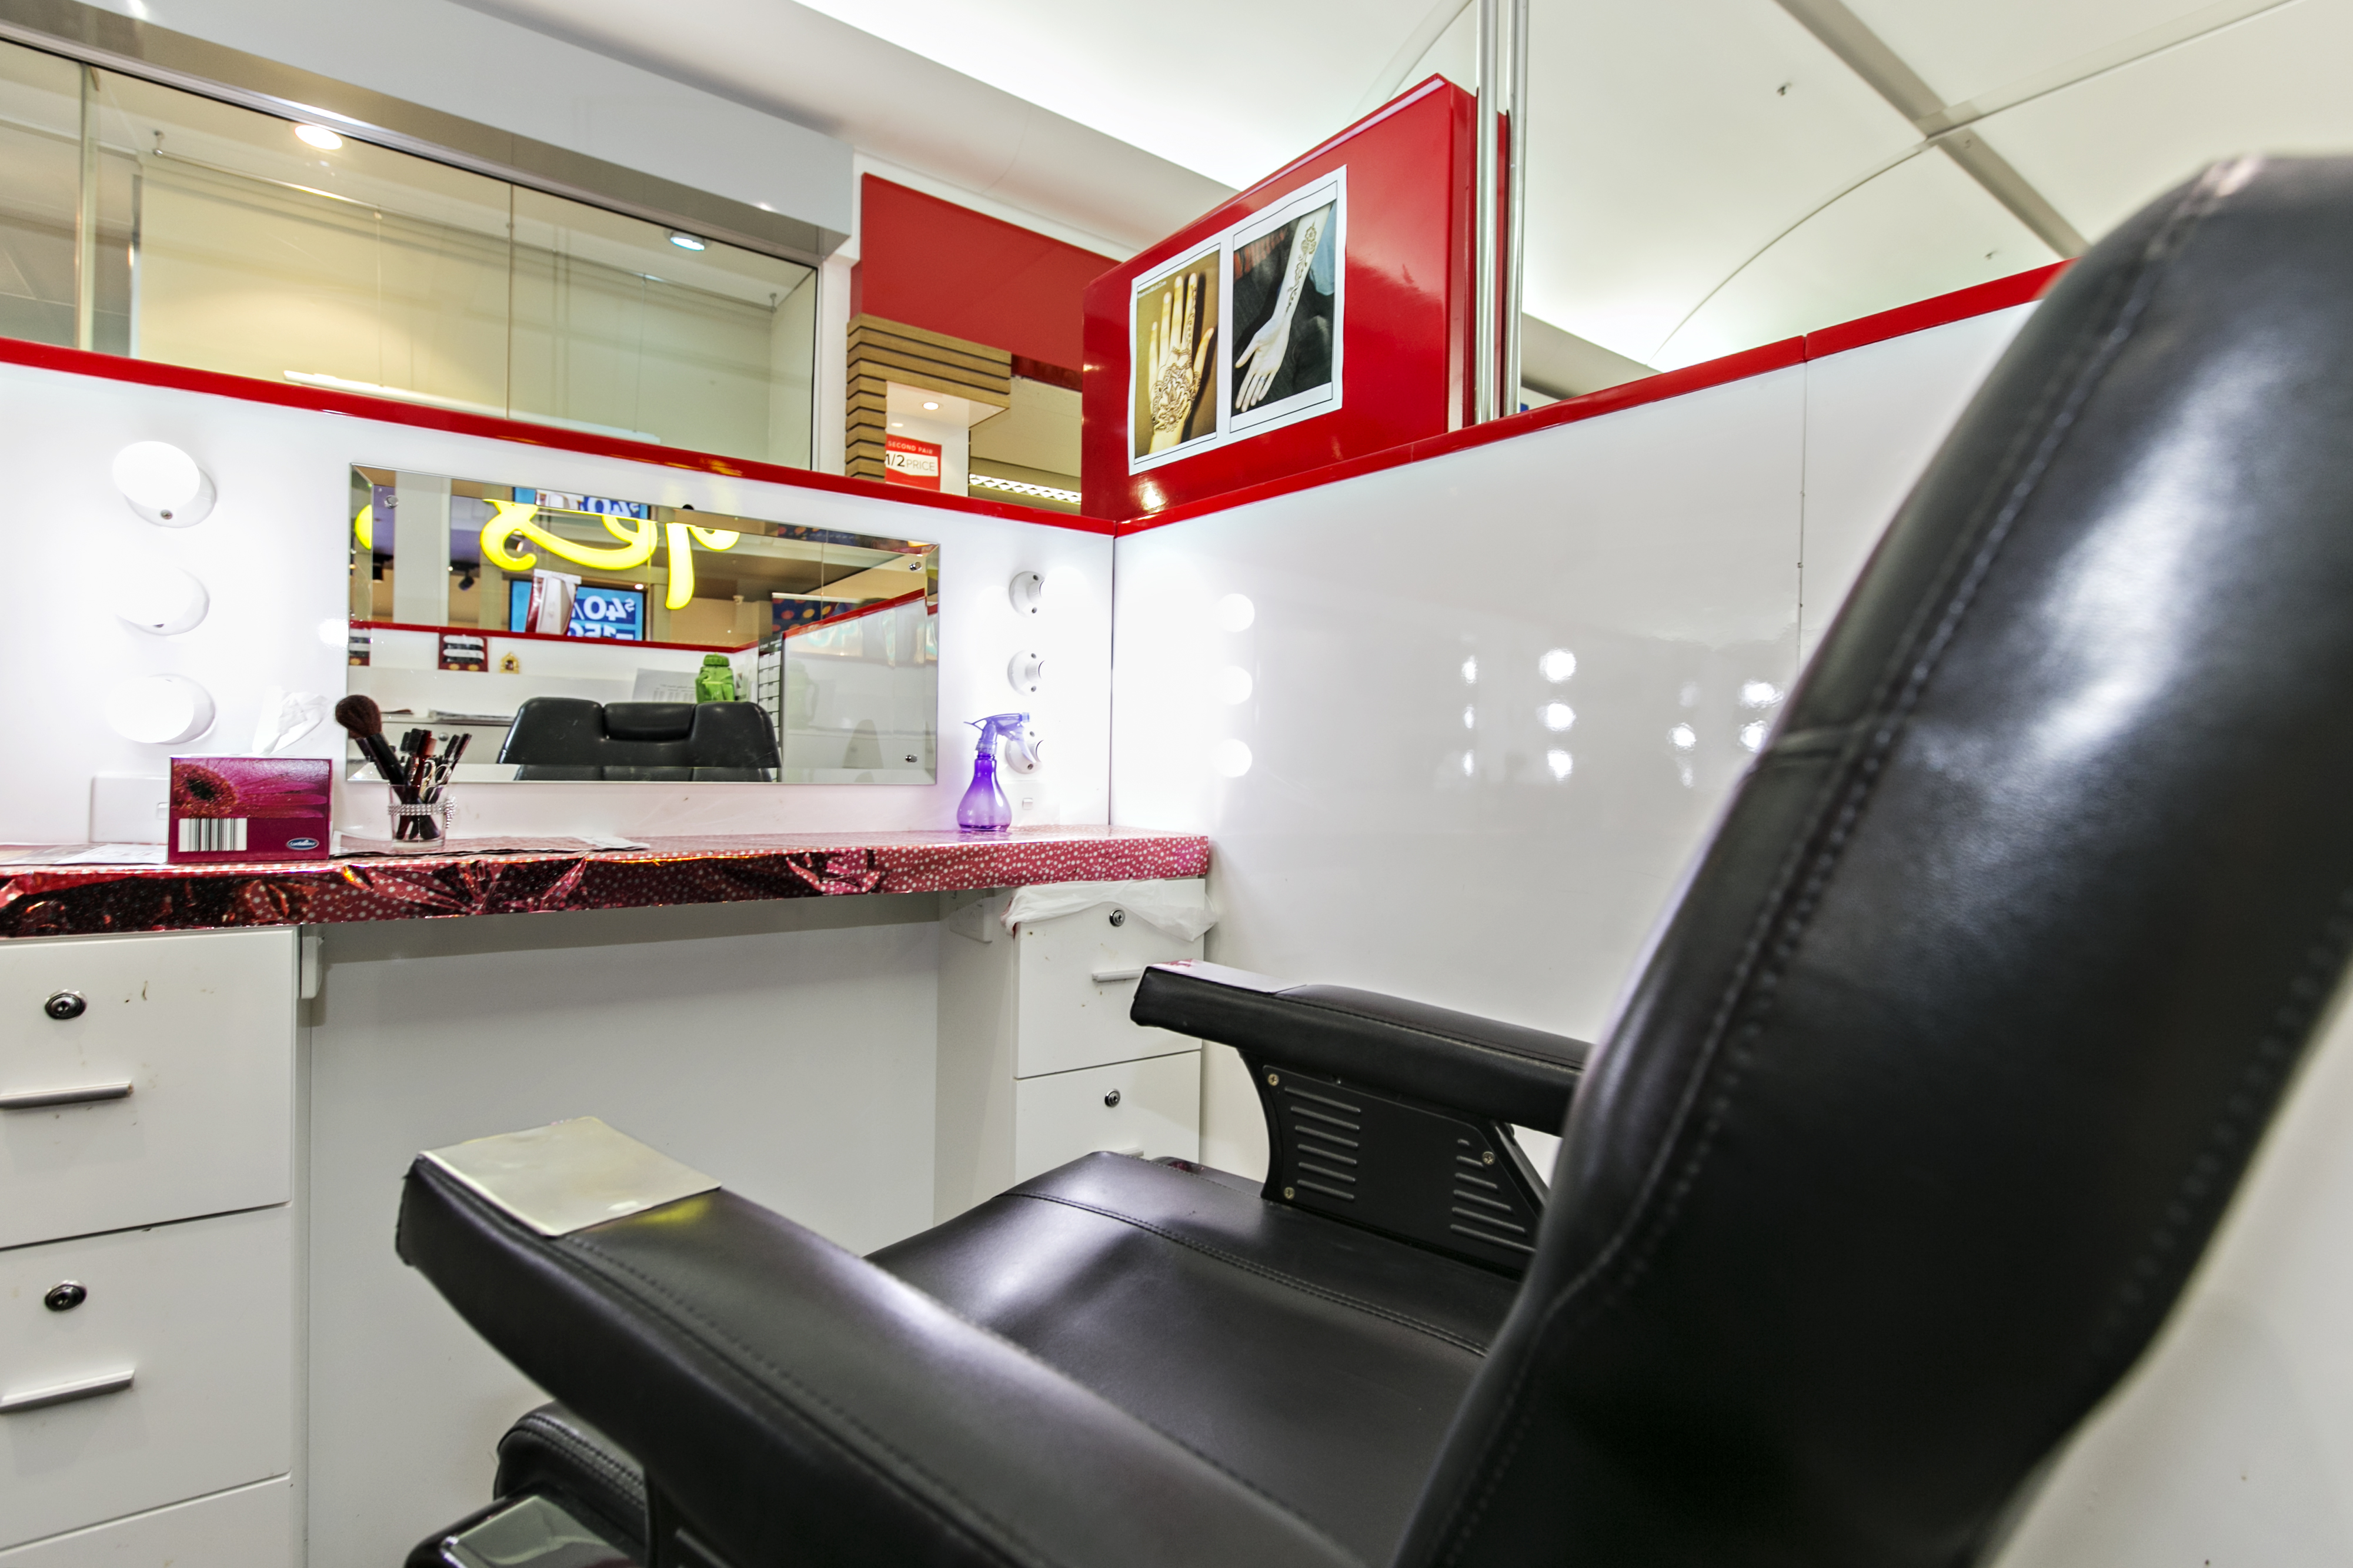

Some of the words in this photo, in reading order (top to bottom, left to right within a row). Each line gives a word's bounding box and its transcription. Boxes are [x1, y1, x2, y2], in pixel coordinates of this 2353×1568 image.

[887, 440, 916, 452] SECOND
[918, 447, 933, 455] PAIR
[886, 453, 905, 467] 1/2
[906, 459, 935, 472] PRICE
